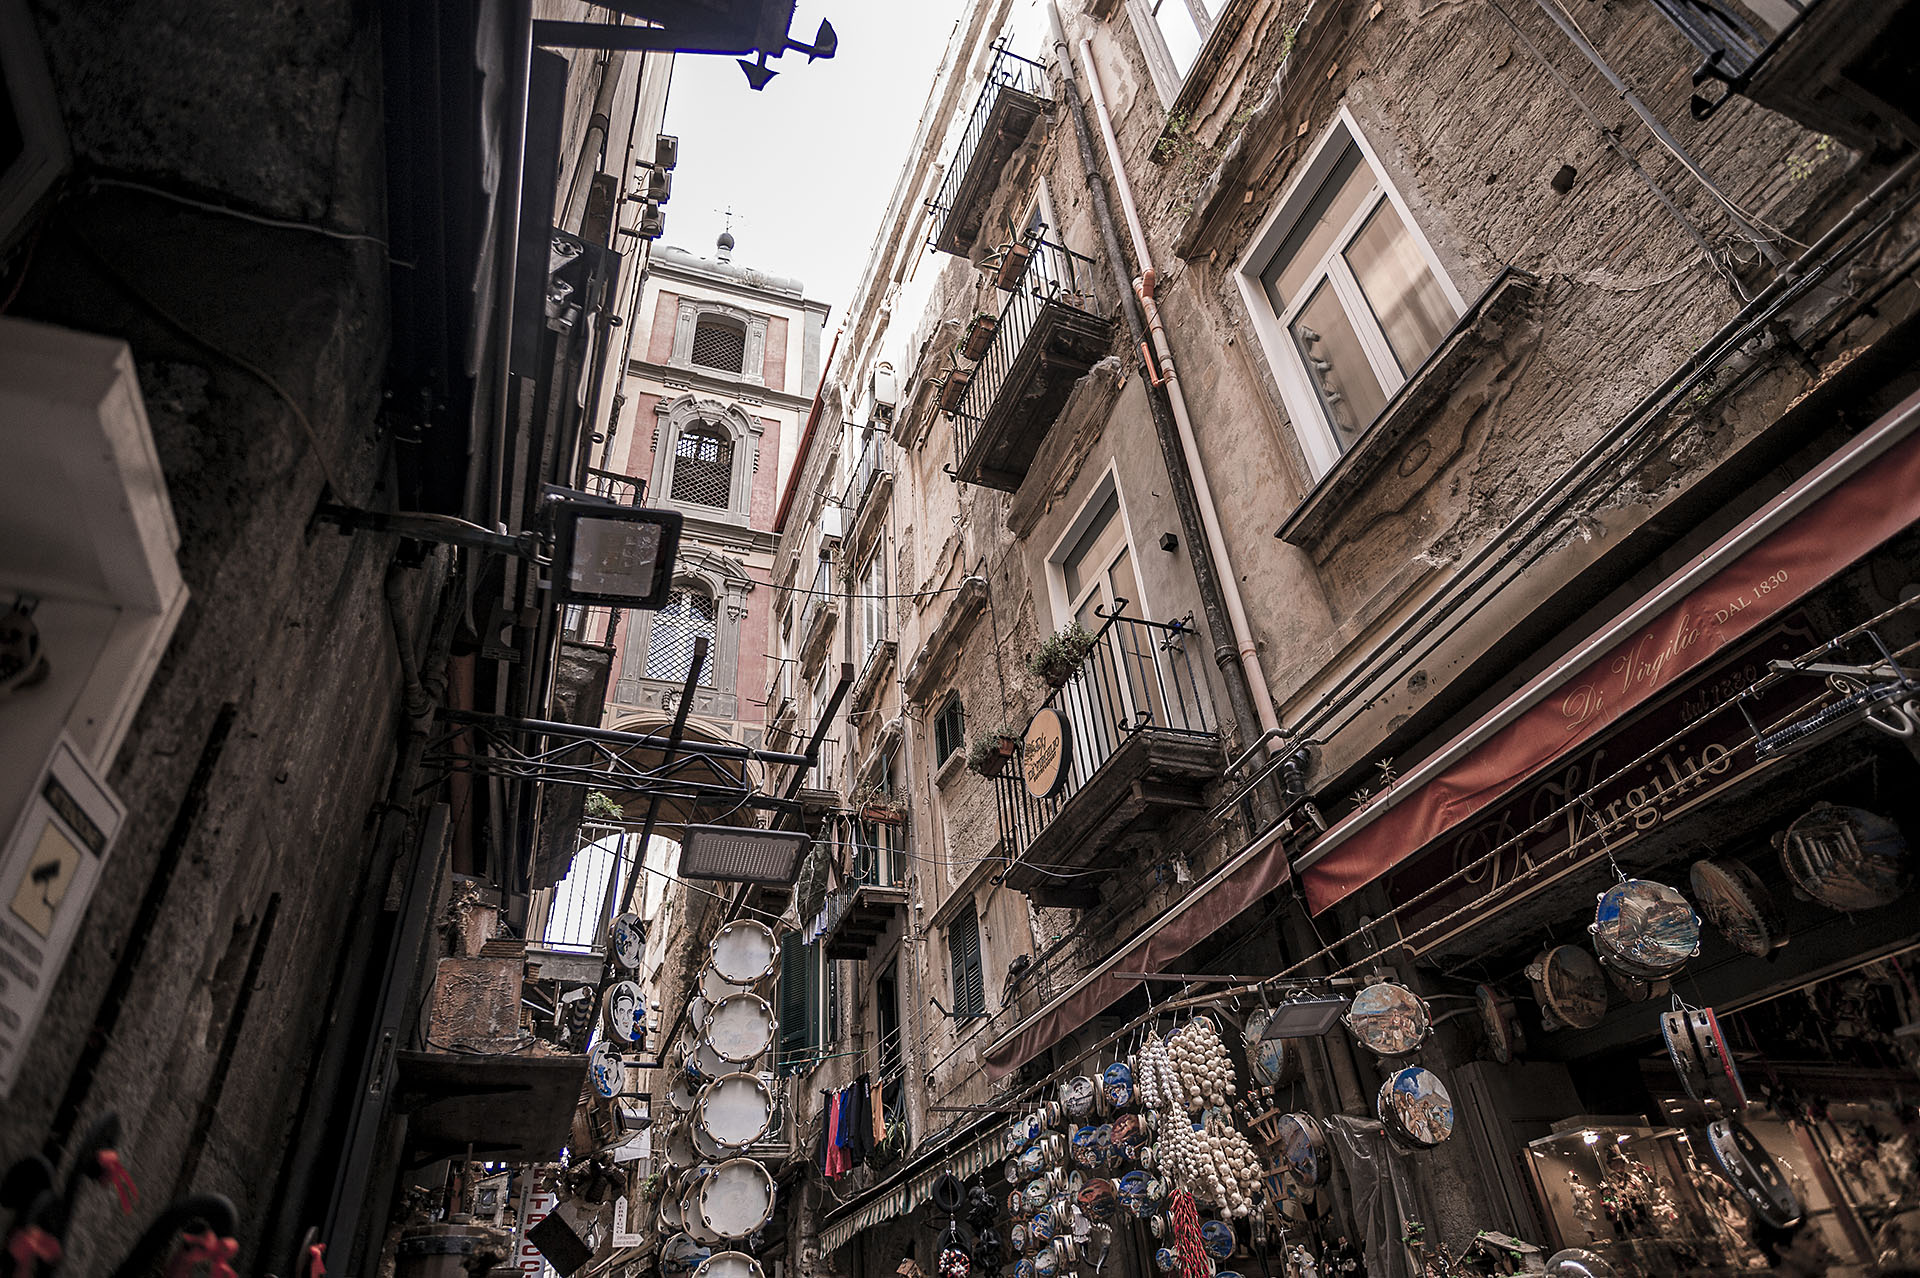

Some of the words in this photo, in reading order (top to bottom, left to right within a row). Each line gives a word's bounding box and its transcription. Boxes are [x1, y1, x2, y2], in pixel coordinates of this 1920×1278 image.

[1562, 682, 1604, 730] Di
[1611, 614, 1701, 694] Virgilio
[1715, 597, 1752, 625] DAL
[1753, 569, 1789, 599] 1830
[1453, 810, 1542, 911] Di
[1528, 742, 1733, 860] Virgilio
